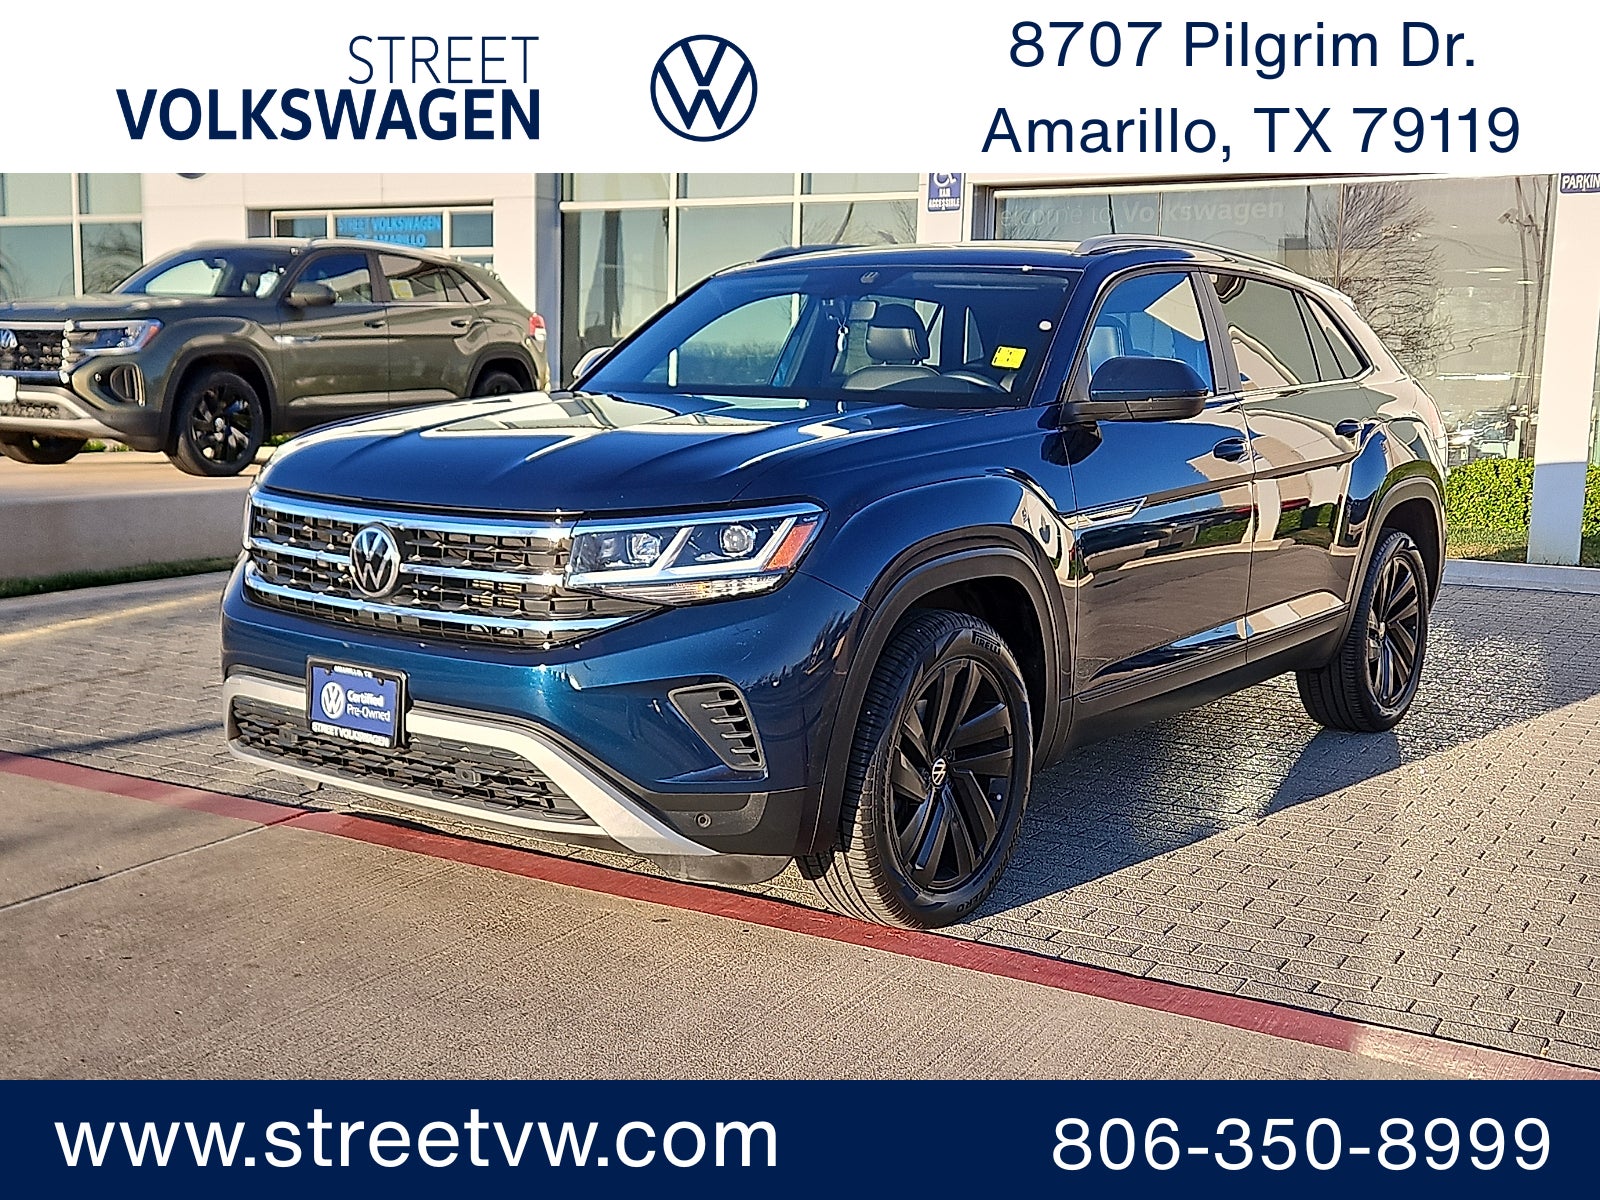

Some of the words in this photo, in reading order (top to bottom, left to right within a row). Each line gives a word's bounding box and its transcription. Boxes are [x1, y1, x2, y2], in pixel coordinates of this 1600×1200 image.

[1121, 199, 1284, 225] Vokswagen
[371, 214, 441, 231] VOLKSWAGEN
[972, 630, 1001, 656] PIRELLI
[347, 689, 384, 708] Certified
[347, 704, 391, 722] Pre-Owned
[312, 721, 338, 737] STREET
